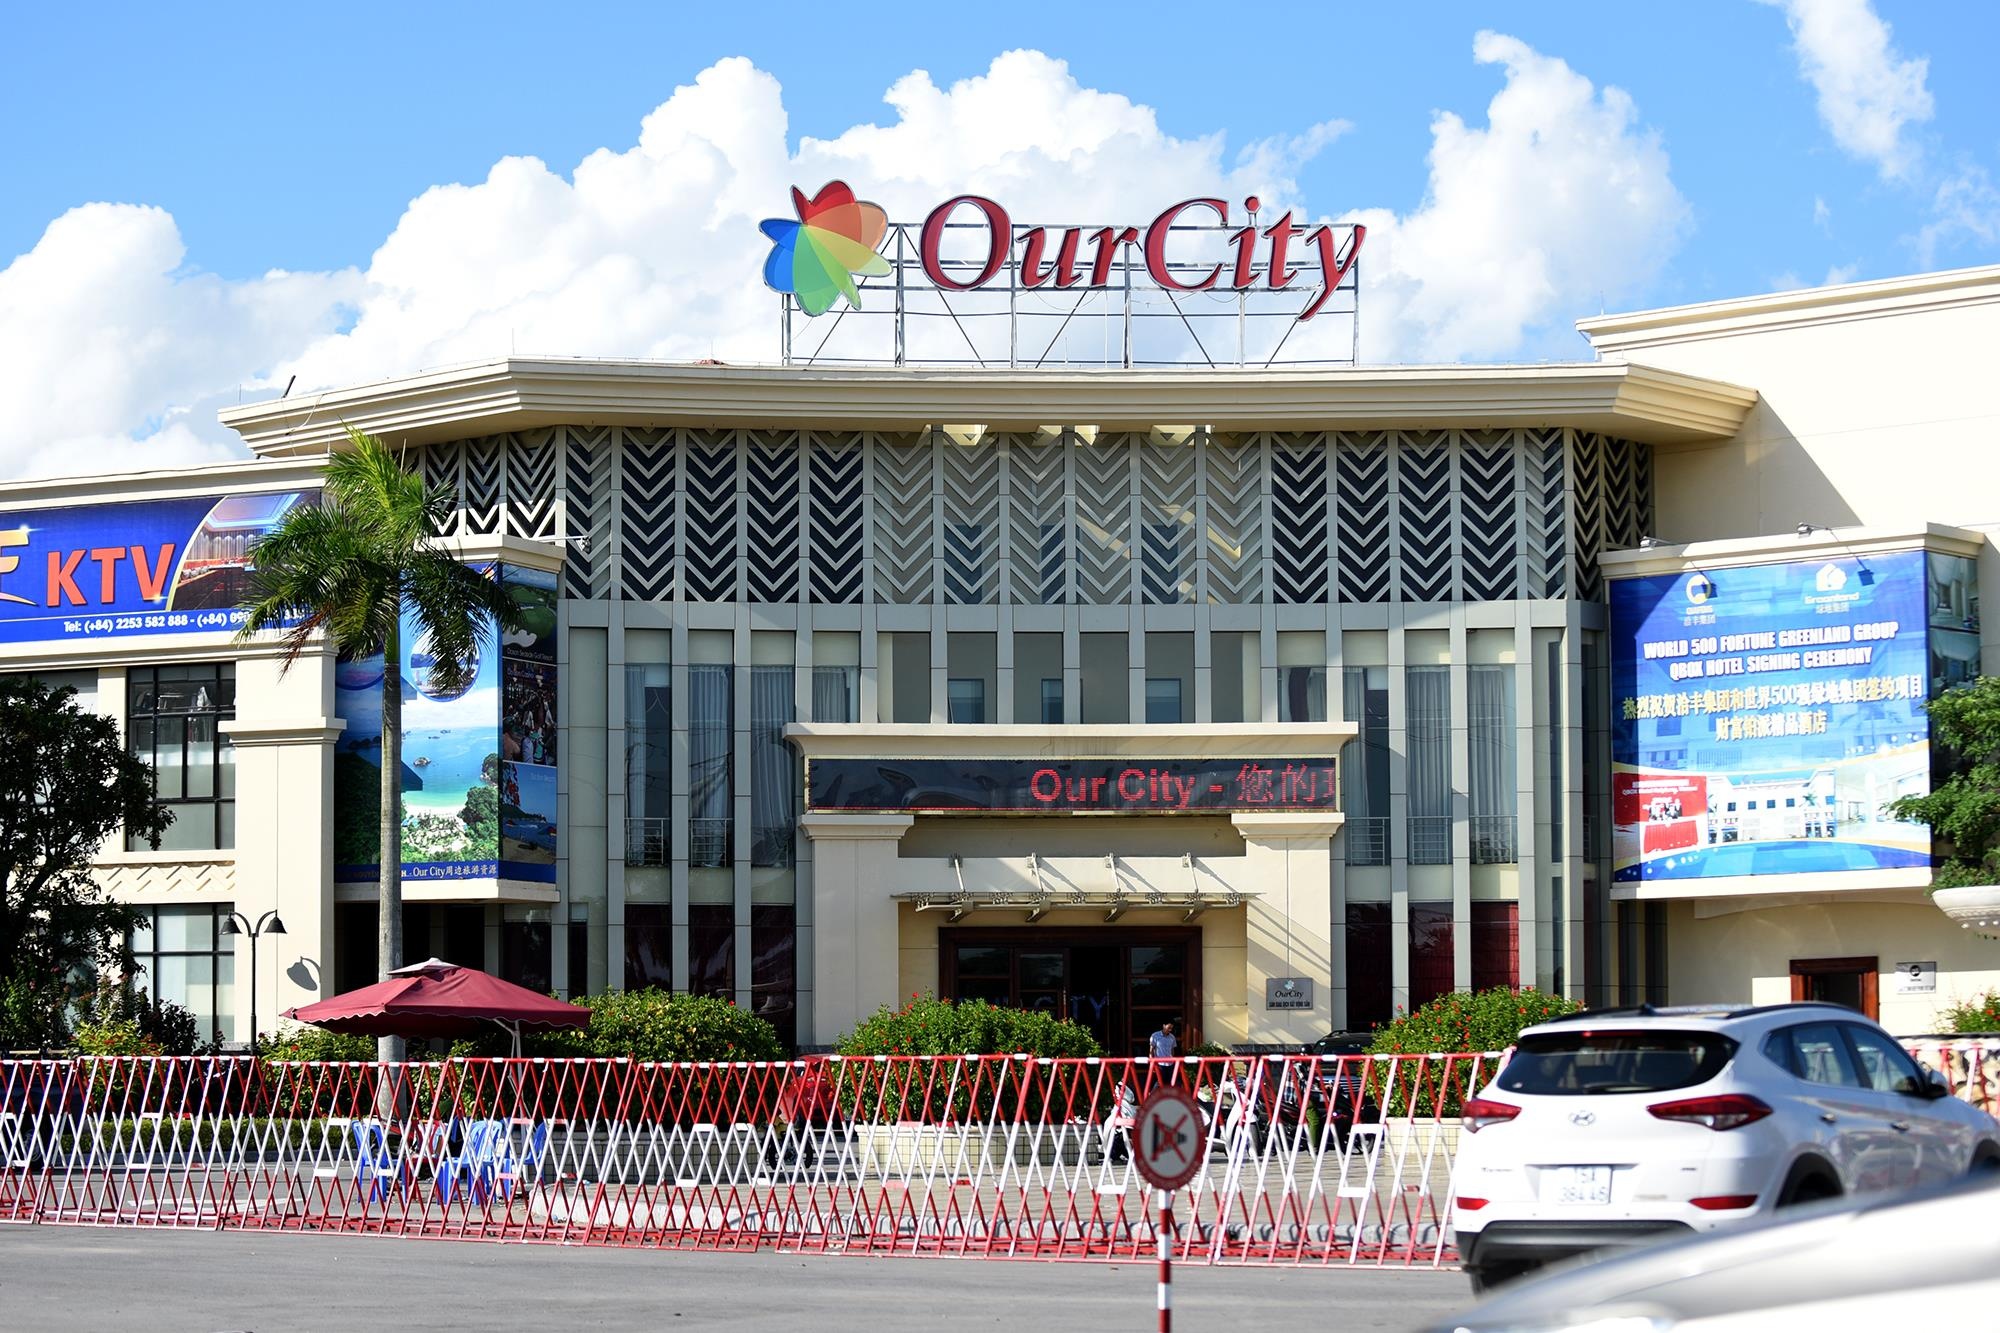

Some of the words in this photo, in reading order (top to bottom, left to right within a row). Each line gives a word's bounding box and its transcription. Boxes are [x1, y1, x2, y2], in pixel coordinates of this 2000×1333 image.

[47, 543, 175, 607] KTV
[64, 621, 82, 632] Tel:
[84, 619, 113, 634] (+84)
[116, 617, 142, 629] 2253
[145, 616, 165, 628] 582
[167, 614, 188, 626] 888
[197, 613, 227, 627] (+84)
[1643, 640, 1688, 660] WORLD
[1691, 637, 1717, 656] 500
[1720, 632, 1776, 653] FORTUNE
[1778, 626, 1850, 648] GREENLAND
[1853, 621, 1899, 641] GROUP
[1669, 661, 1704, 681] QBOX
[1706, 657, 1744, 676] HOTEL
[1746, 652, 1800, 673] SIGNING
[1803, 647, 1873, 668] CEREMONY
[1030, 769, 1106, 801] Our
[1117, 768, 1196, 809] City
[413, 867, 428, 877] Our
